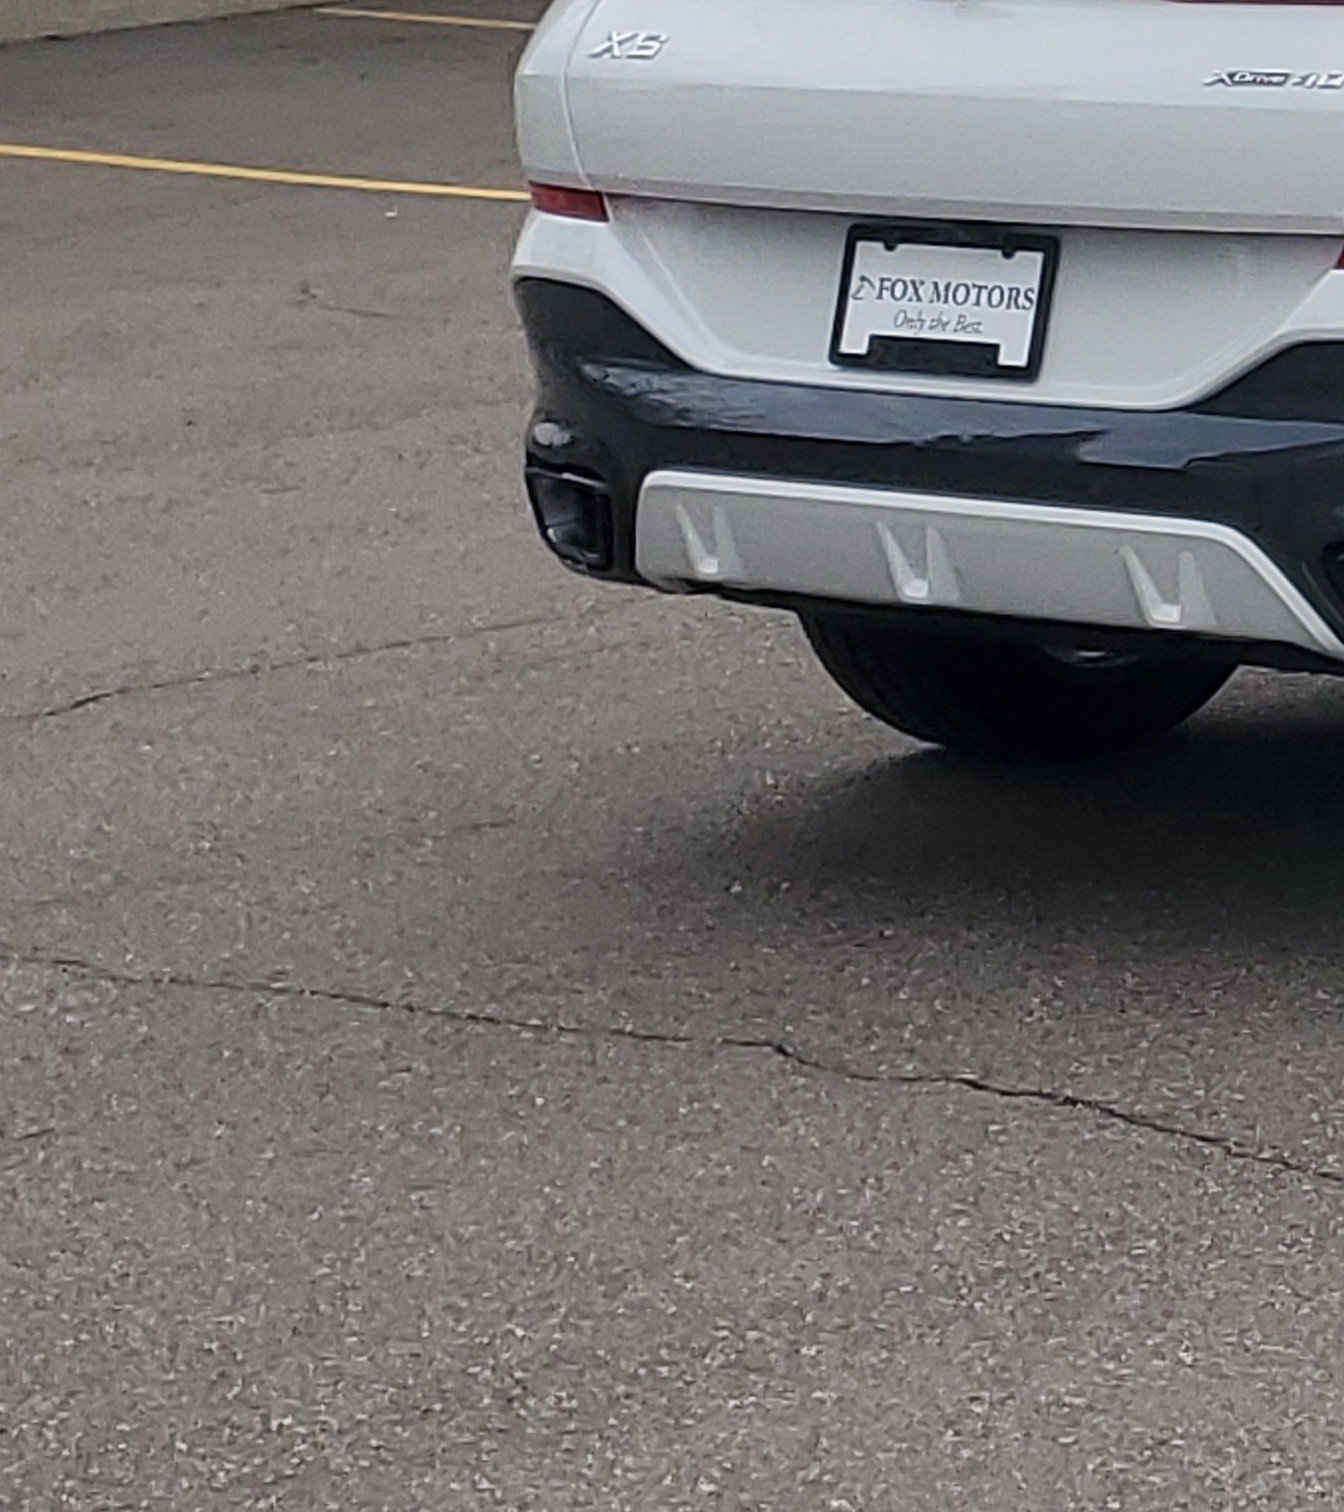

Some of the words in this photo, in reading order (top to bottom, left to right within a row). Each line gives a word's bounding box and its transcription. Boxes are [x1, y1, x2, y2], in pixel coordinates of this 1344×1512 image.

[876, 276, 925, 303] FOX
[928, 280, 1035, 311] MOTORS
[893, 309, 926, 335] Only
[928, 311, 950, 332] the
